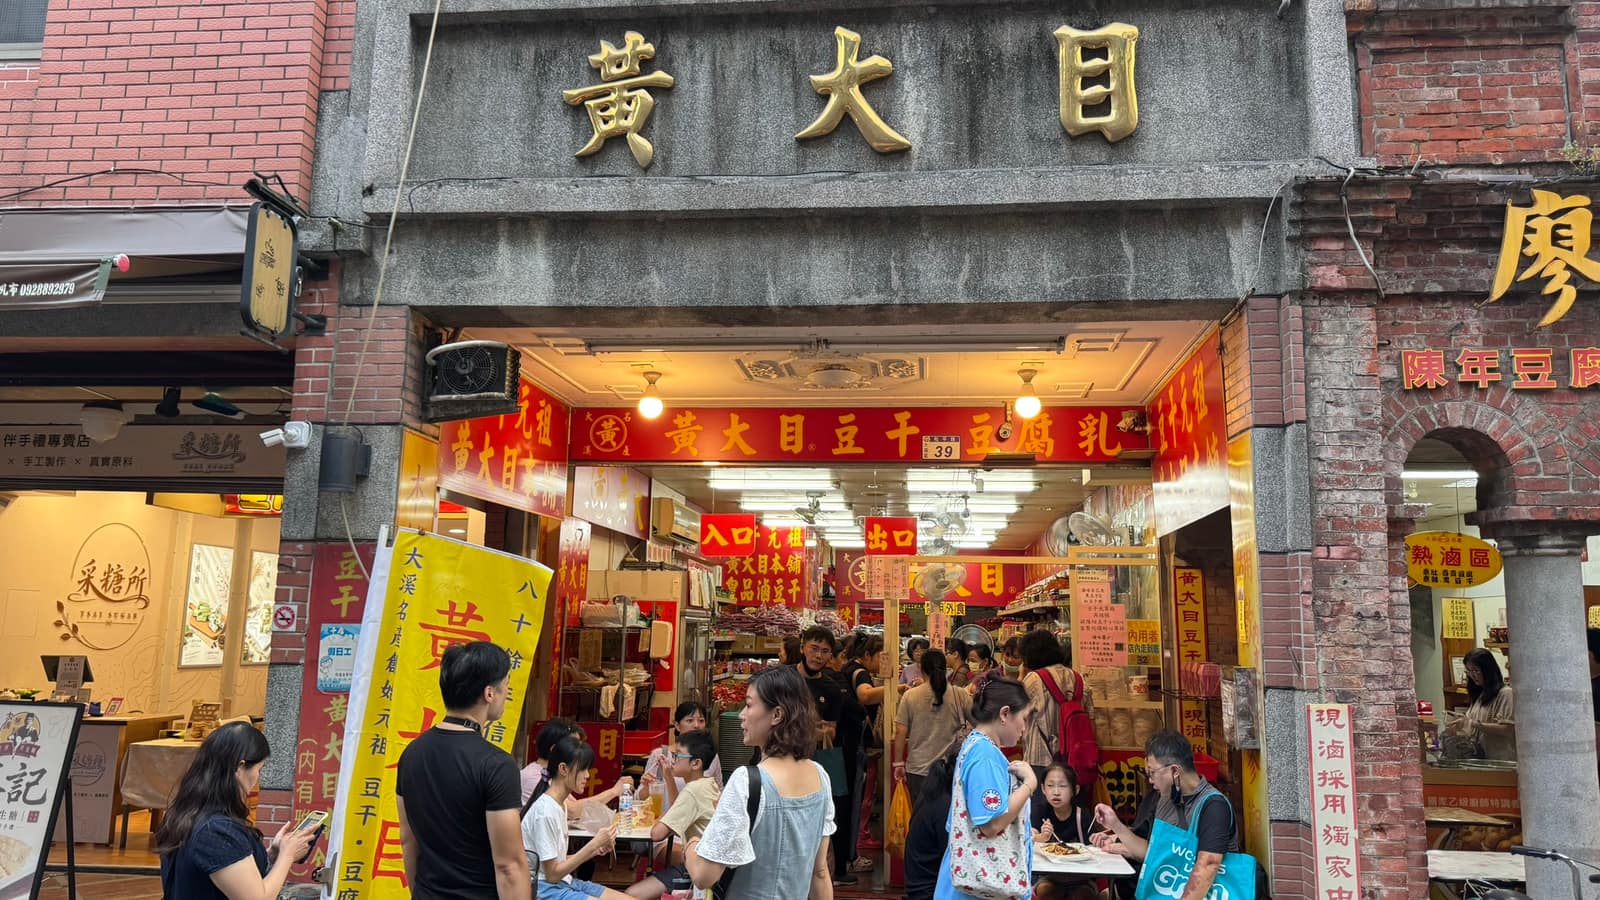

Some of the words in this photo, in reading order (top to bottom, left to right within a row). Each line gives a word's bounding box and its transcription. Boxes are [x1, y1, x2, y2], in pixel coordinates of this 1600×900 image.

[562, 25, 1139, 171] 黃大目
[1489, 187, 1600, 329] 廖
[20, 282, 76, 297] 0928892979
[499, 384, 552, 447] 元祖
[934, 445, 953, 458] 39
[701, 523, 754, 546] 入口
[755, 526, 804, 549] 元祖
[867, 524, 914, 551] 出口
[1411, 545, 1490, 568] 熱滷區
[72, 558, 149, 606] 采糖所
